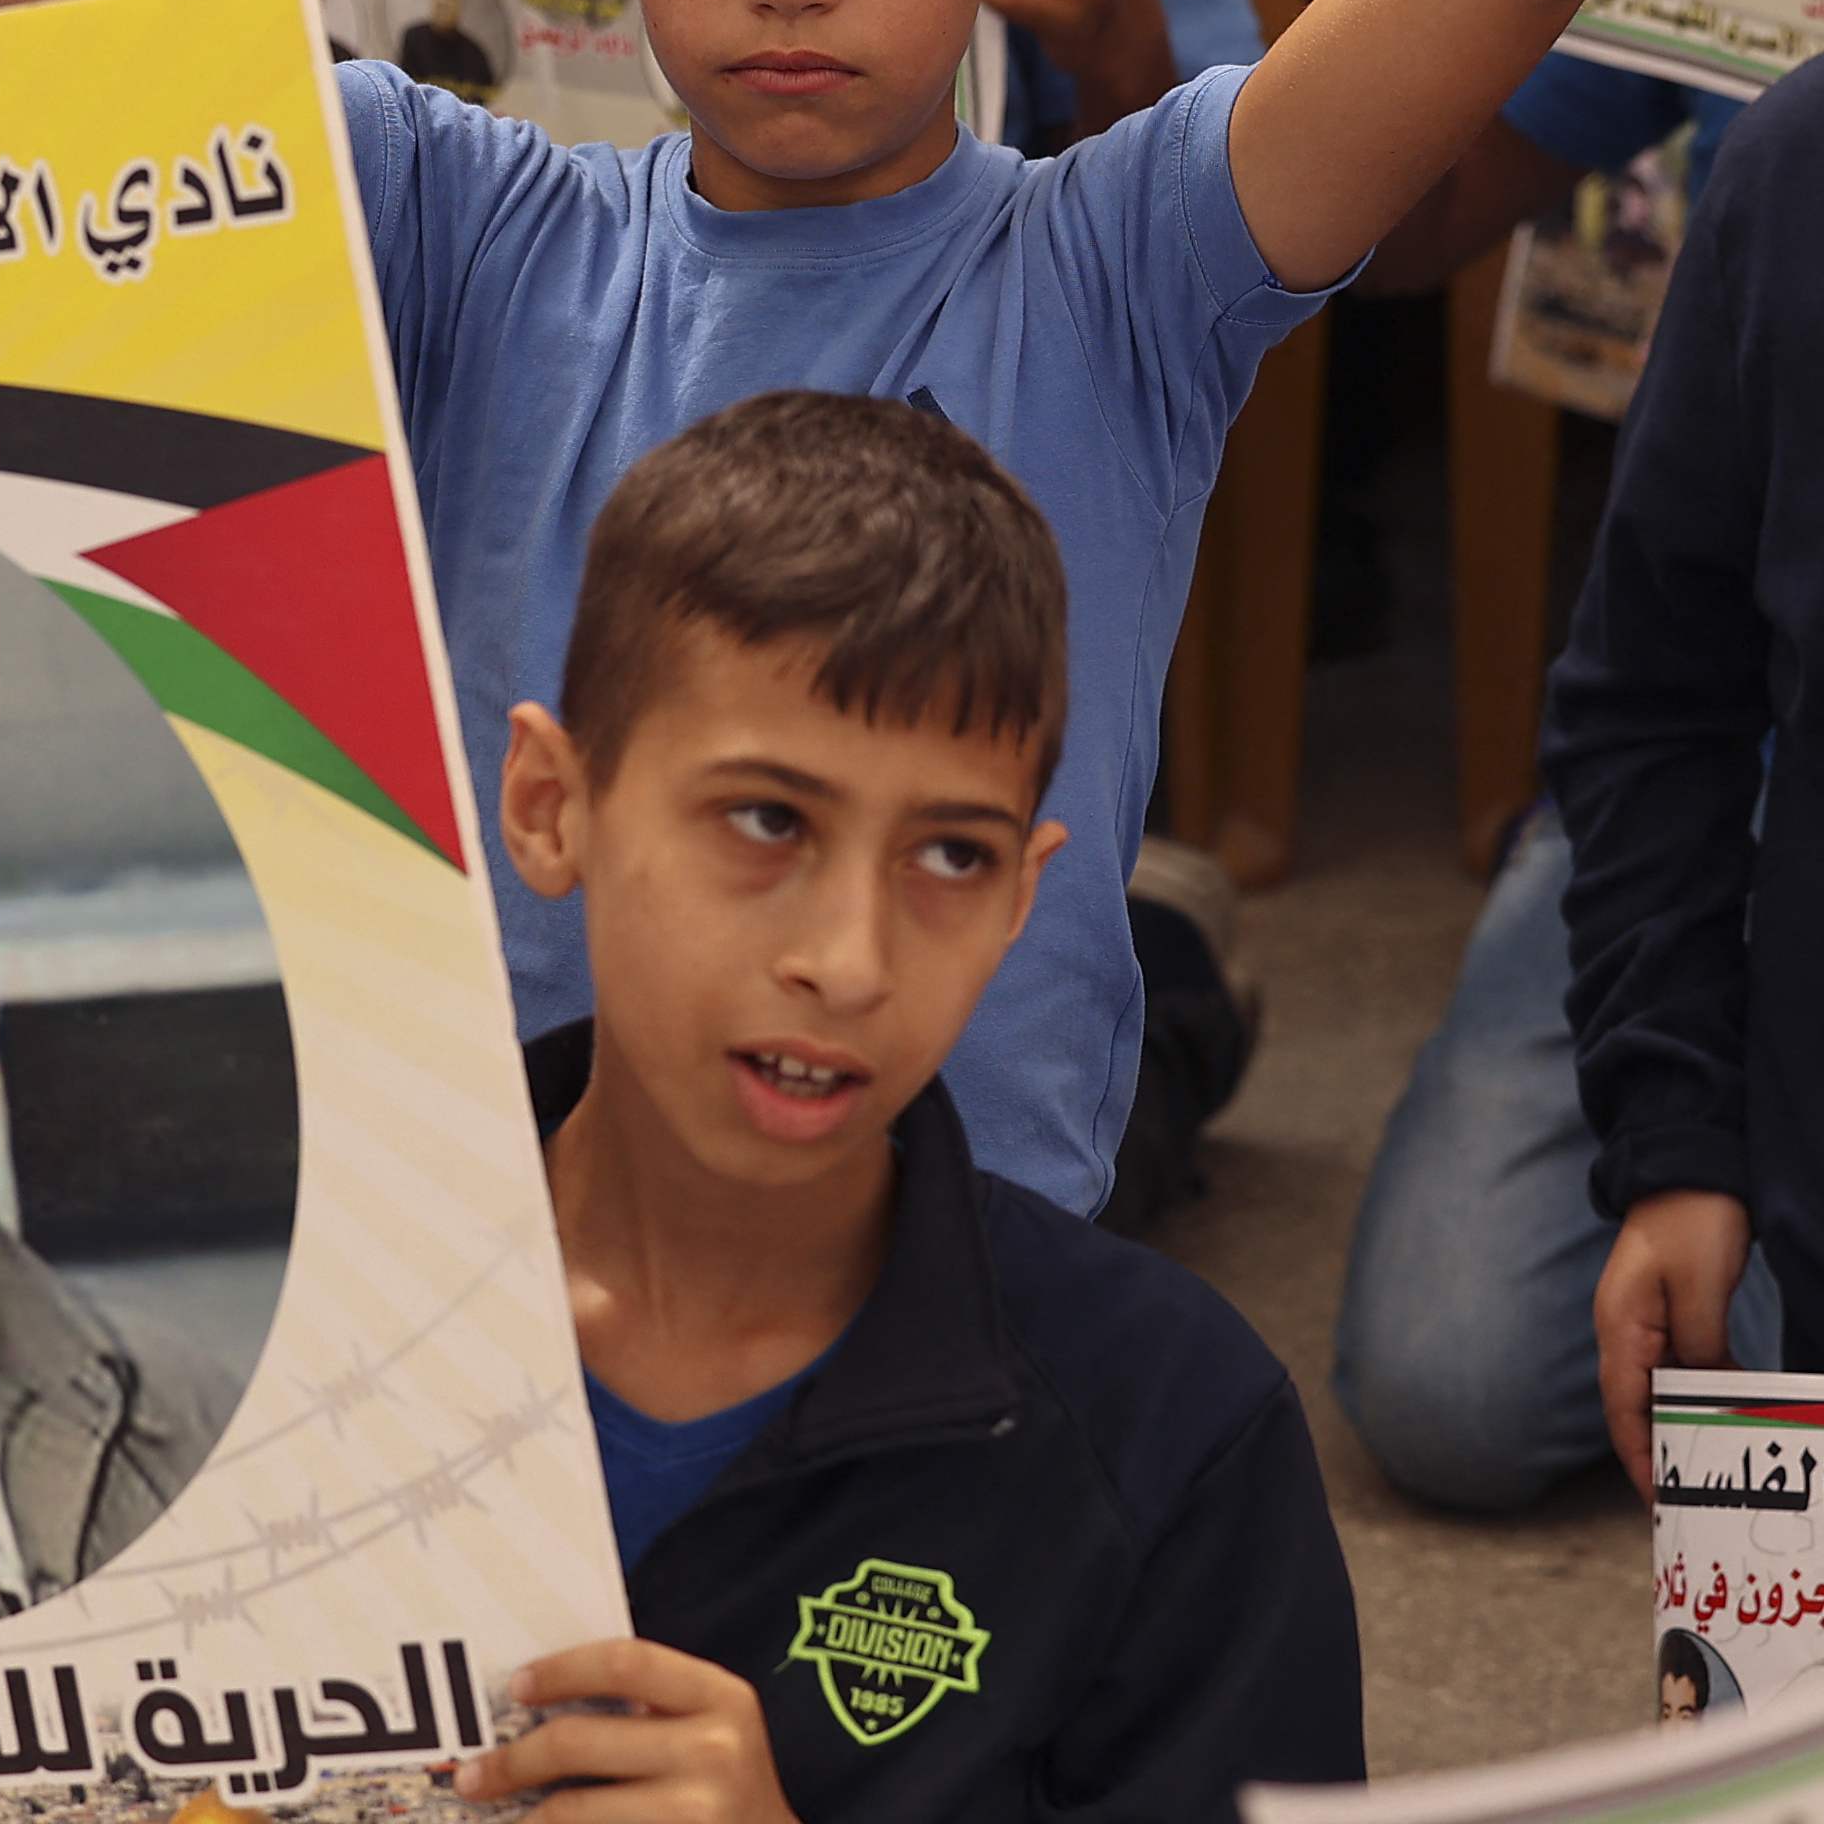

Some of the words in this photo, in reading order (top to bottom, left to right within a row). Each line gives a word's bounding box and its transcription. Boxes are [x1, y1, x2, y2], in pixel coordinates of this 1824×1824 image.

[79, 124, 290, 282] نادي
[1692, 1569, 1730, 1633] في
[825, 1612, 955, 1672] DIVISION
[129, 1639, 482, 1808] الحرية
[849, 1686, 906, 1719] 1985
